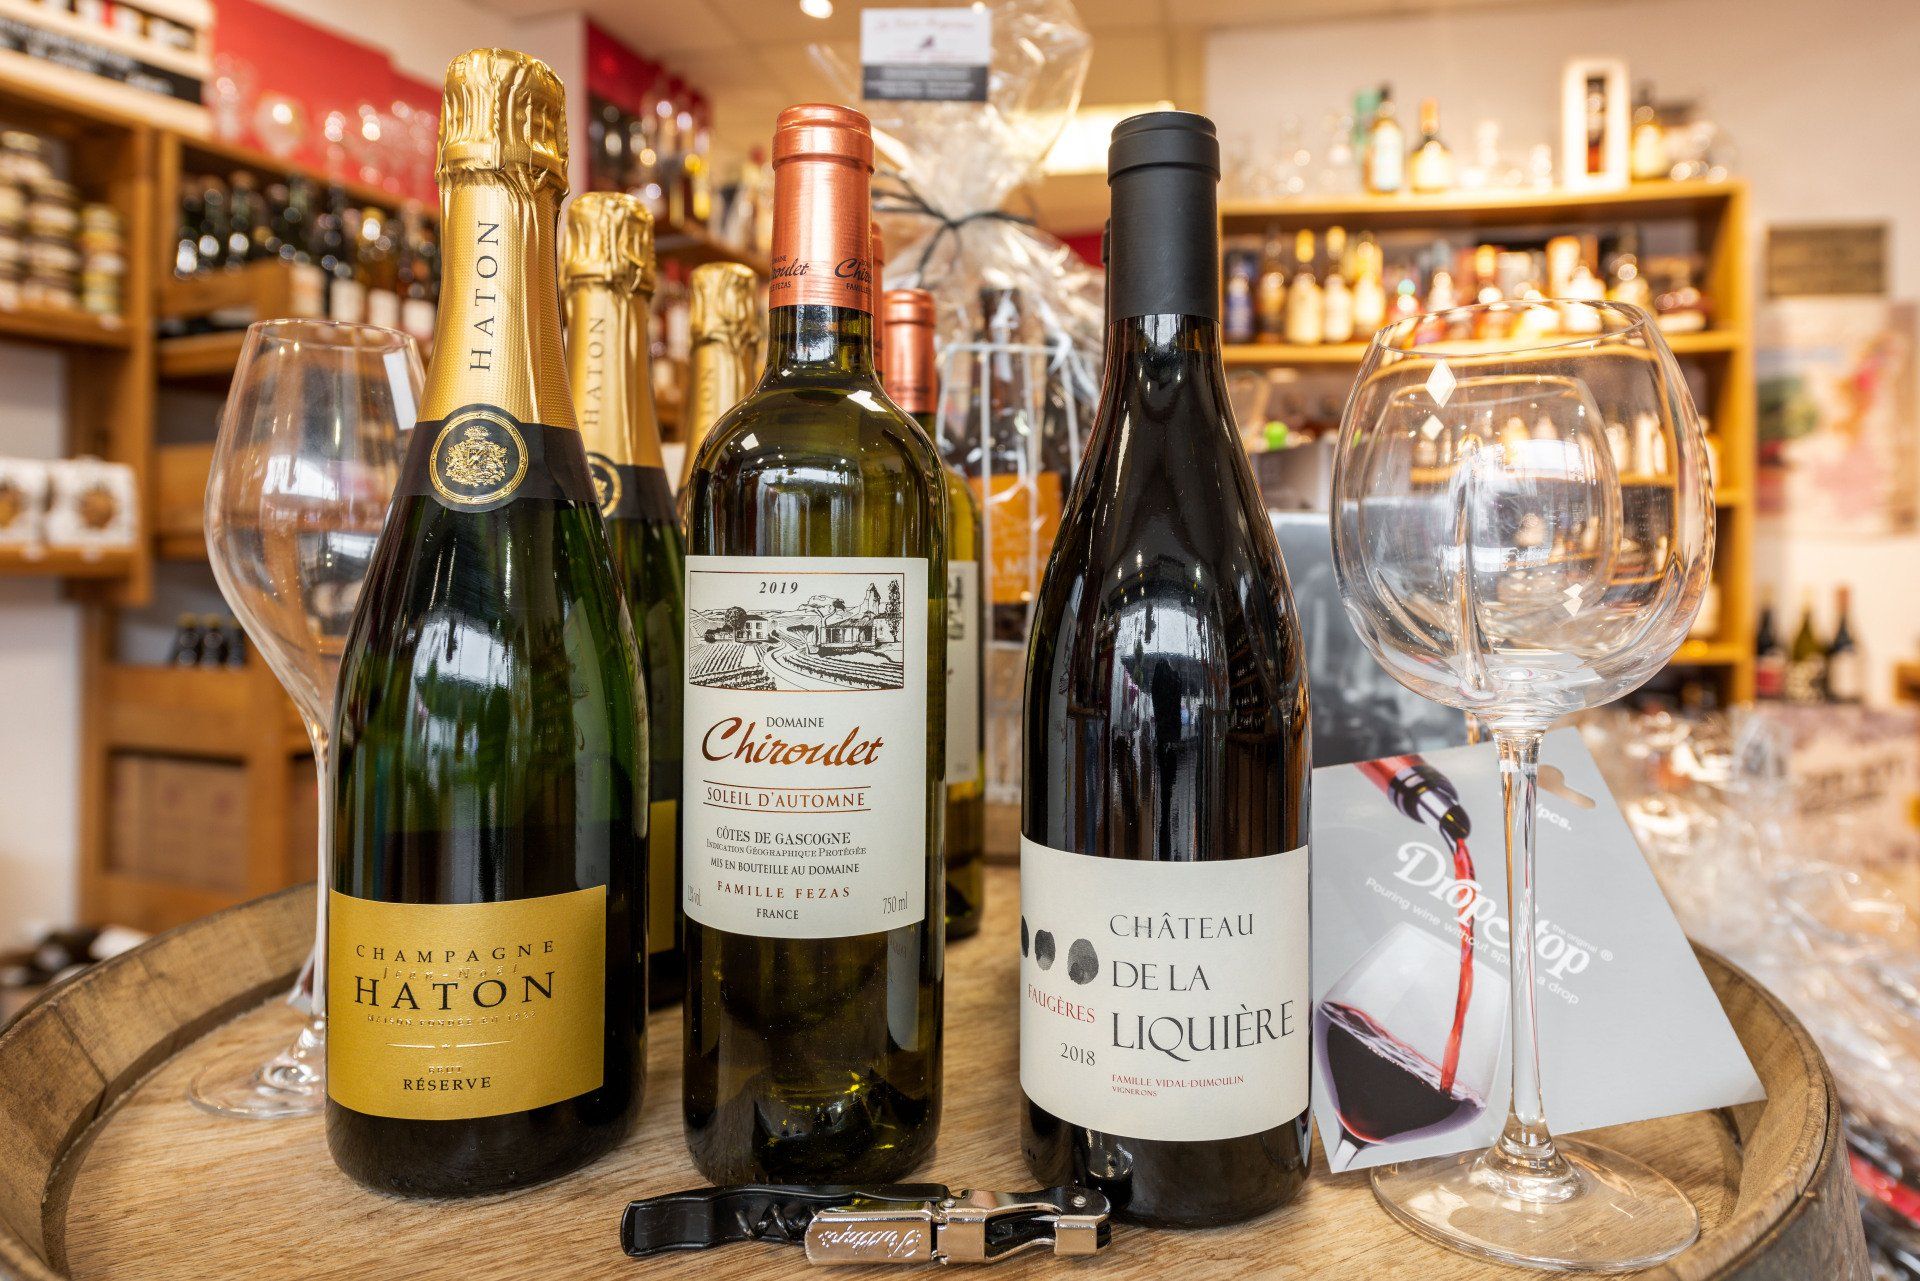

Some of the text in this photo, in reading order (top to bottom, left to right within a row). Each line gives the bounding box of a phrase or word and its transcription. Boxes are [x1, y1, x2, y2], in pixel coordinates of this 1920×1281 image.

[469, 221, 500, 372] HATON
[583, 317, 606, 426] HATON
[759, 581, 798, 594] 2019
[766, 716, 825, 728] DOMAINE
[702, 716, 885, 767] Chiroulet
[707, 787, 865, 808] SOLEIL D'AUTOMNE
[754, 832, 771, 844] DE
[775, 832, 851, 846] GASCOGNE
[710, 857, 860, 876] MIS EN BOUTEILLE AU DOMAINE
[717, 880, 850, 899] FAMILLE FEZAS
[756, 907, 799, 920] FRANCE
[882, 891, 908, 914] 750 ml
[1109, 912, 1254, 940] CHÂTEAU
[356, 940, 554, 963] CHAMPAGNE
[1366, 877, 1580, 1005] Pouring wine without a drop
[1112, 960, 1211, 992] DE LA
[354, 971, 556, 1011] HATON
[1028, 983, 1096, 1024] FAUGÈRES
[1111, 1000, 1295, 1063] LIQUIÈRE
[1060, 1042, 1096, 1067] 2018
[403, 1077, 492, 1092] RÉSERVE
[1112, 1073, 1244, 1088] FAMILLE VIDAL-DUMOULIN
[1112, 1085, 1157, 1097] VIGNERONS
